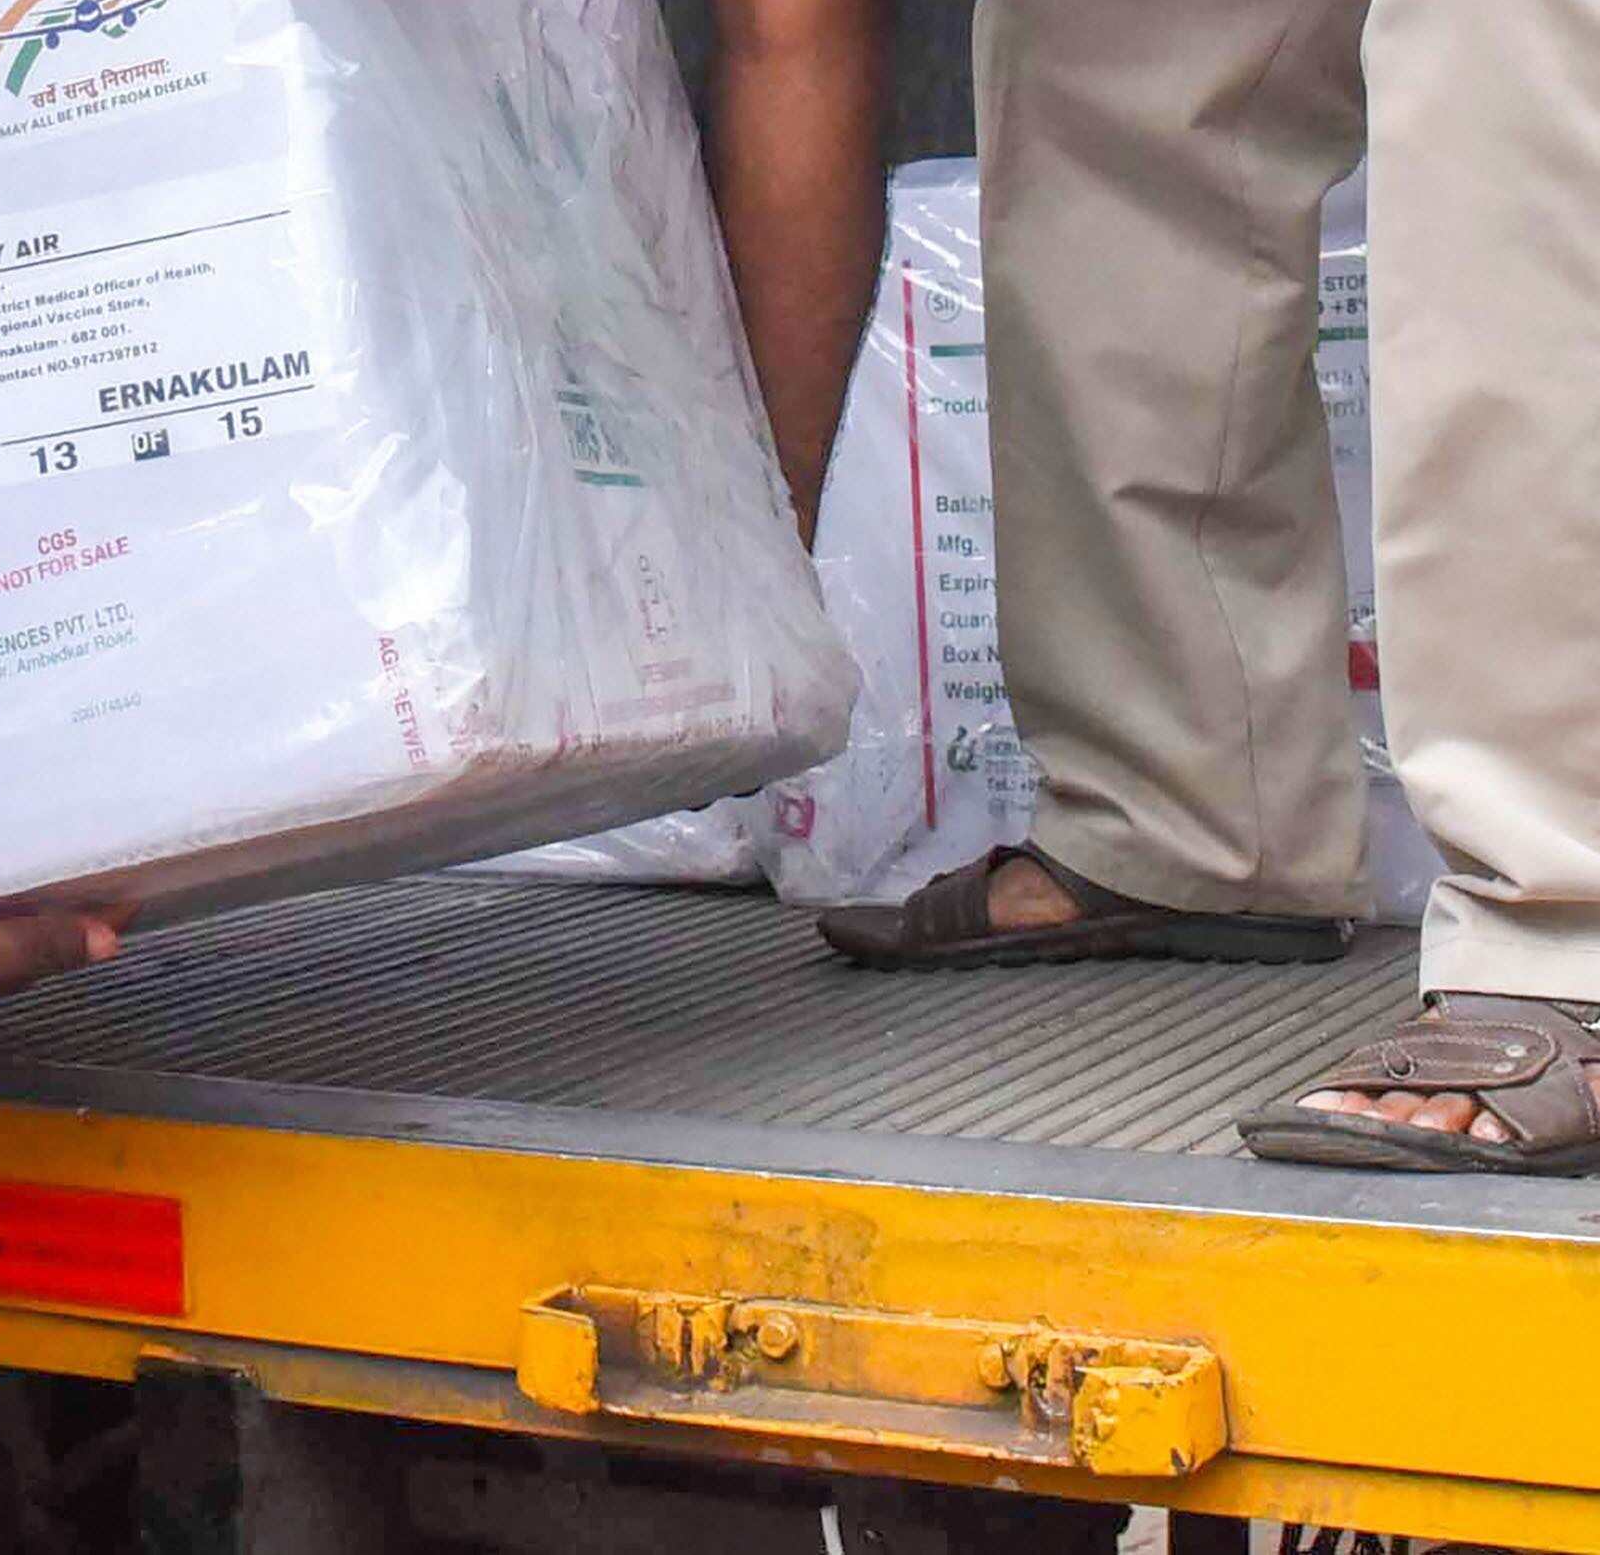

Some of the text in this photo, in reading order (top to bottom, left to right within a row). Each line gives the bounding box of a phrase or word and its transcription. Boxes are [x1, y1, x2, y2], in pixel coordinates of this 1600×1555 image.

[0, 72, 209, 137] MAY ALL BE FREE FROM DISEASE
[15, 233, 60, 259] AIR
[35, 288, 89, 307] Medical
[94, 276, 142, 295] Officer
[145, 271, 160, 284] of
[163, 263, 216, 280] Health,
[47, 307, 104, 325] Vaccine
[71, 328, 97, 344] 682
[99, 350, 311, 414] ERNAKULAM
[31, 407, 263, 475] 13 OF 15
[936, 495, 994, 513] Batch
[38, 528, 78, 555] CGS
[937, 535, 979, 557] Mfg.
[38, 554, 78, 581] FOR
[81, 536, 131, 567] SALE
[54, 614, 91, 639] PVT.
[943, 644, 979, 664] Box
